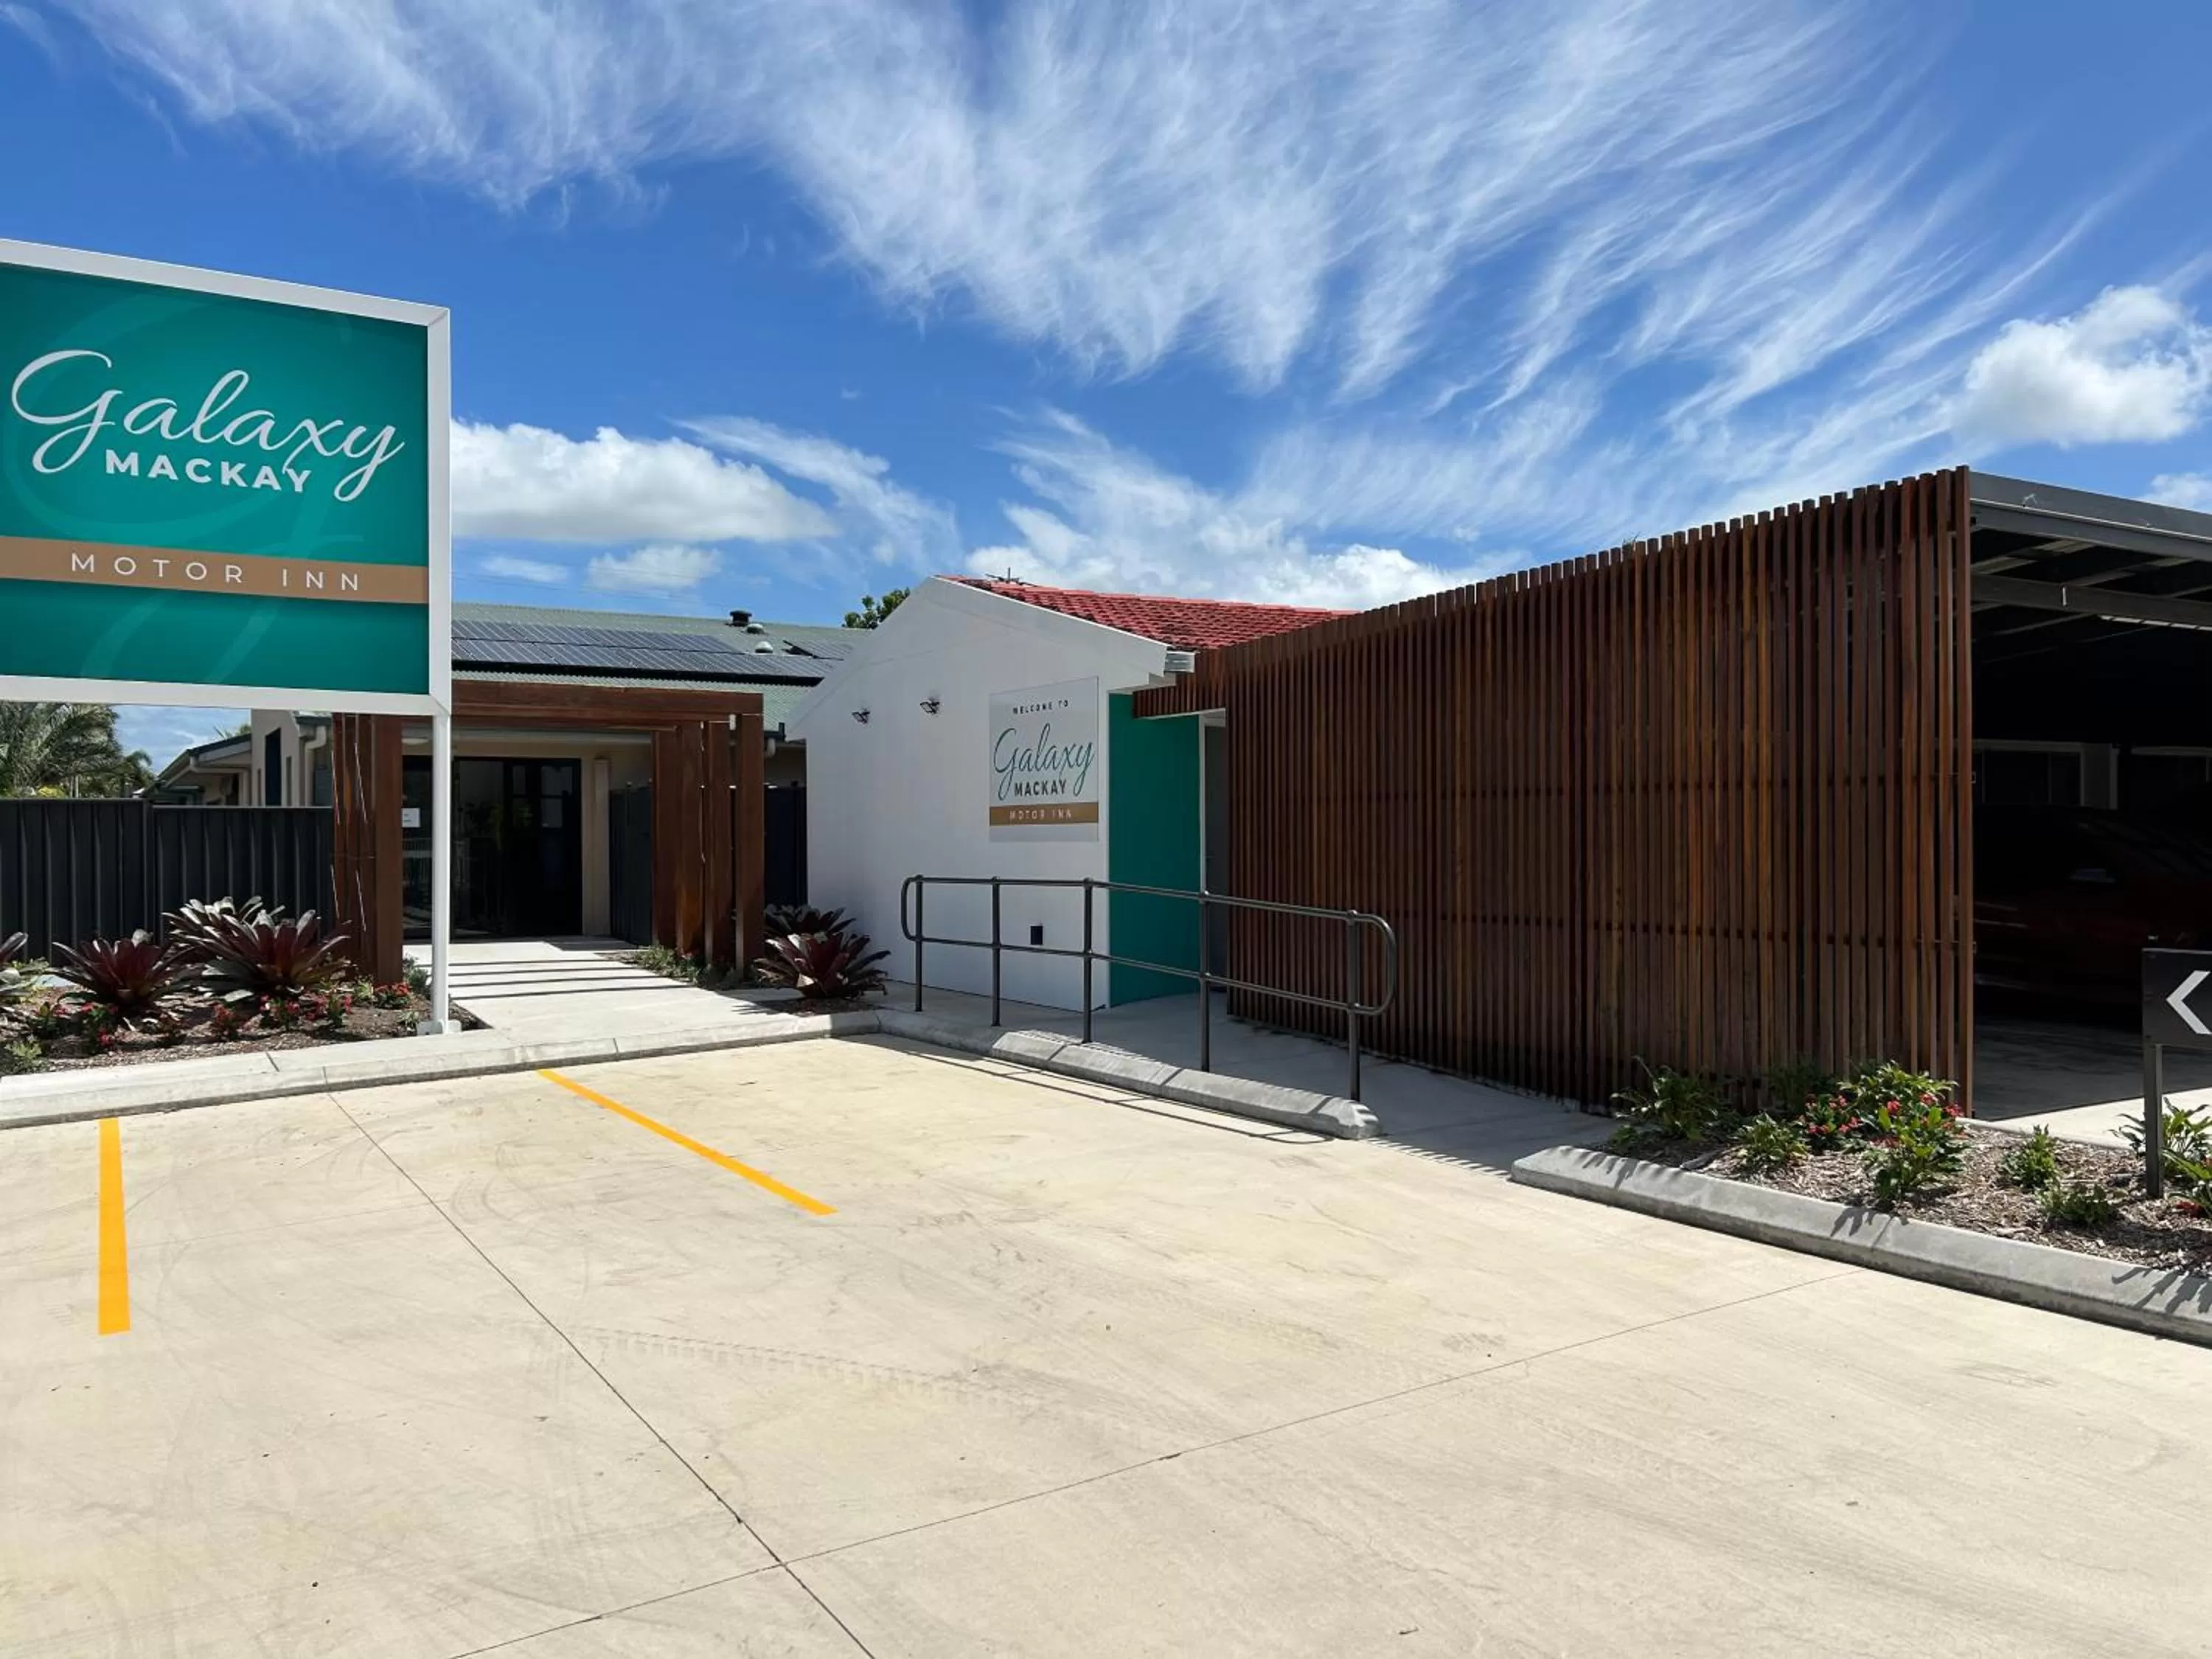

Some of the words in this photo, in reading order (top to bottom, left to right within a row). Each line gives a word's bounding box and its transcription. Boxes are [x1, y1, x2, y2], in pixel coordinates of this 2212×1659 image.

[11, 349, 405, 502] Galaxy
[105, 448, 313, 493] MACKAY
[71, 552, 243, 584] MOTOR
[282, 568, 359, 591] INN
[1012, 701, 1052, 714] WELCOME
[1058, 700, 1068, 708] TO
[993, 723, 1094, 801] Galaxy
[1015, 779, 1067, 796] MACKAY
[1009, 810, 1045, 820] MOTOR
[1052, 809, 1071, 820] INN
